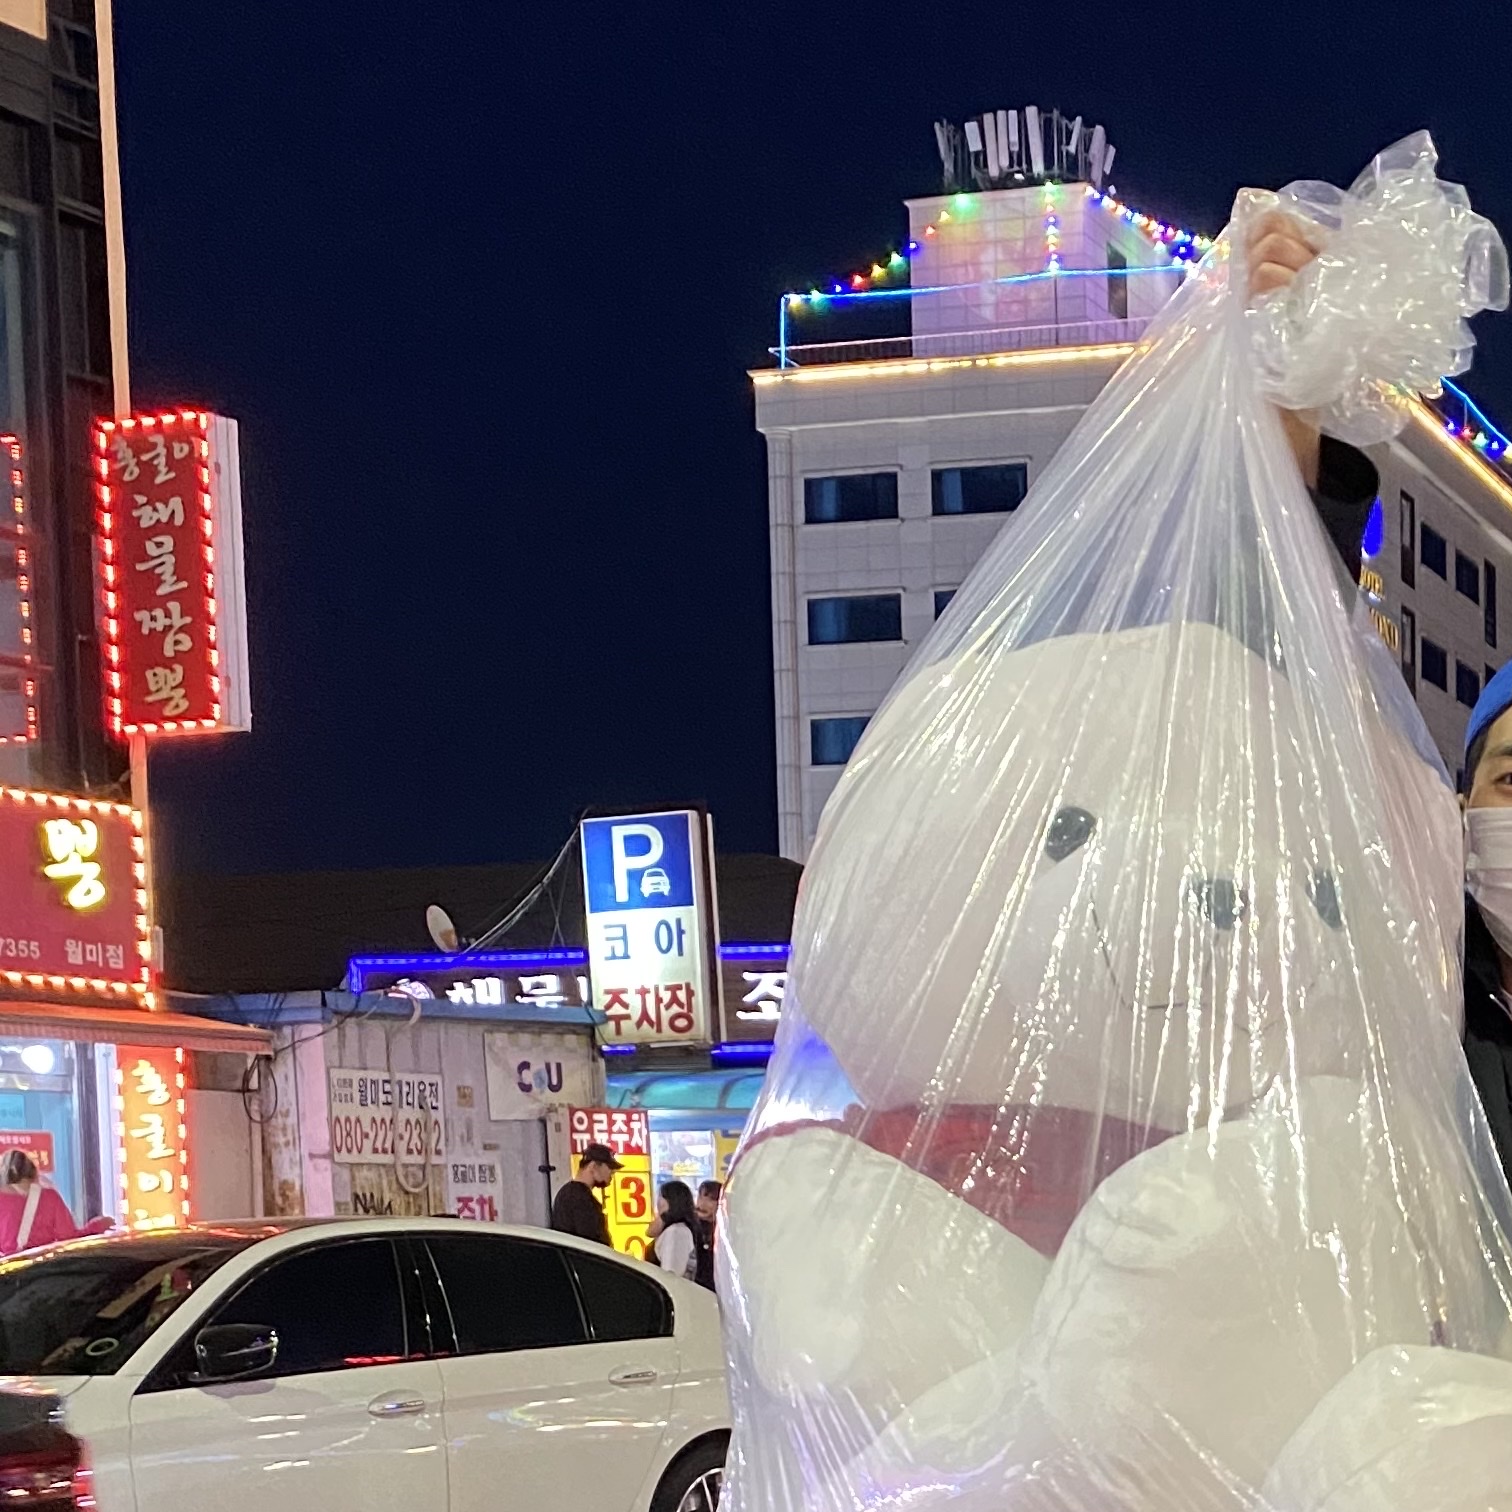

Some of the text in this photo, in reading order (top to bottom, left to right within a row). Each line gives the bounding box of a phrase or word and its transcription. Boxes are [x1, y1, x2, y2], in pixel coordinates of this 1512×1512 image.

[132, 493, 192, 717] 해물짬뽕
[43, 816, 107, 910] 뽕
[610, 823, 664, 903] P
[63, 937, 124, 970] 월미점
[602, 981, 696, 1036] 주차장
[516, 1059, 563, 1094] CU
[572, 1110, 648, 1154] 유료주차
[620, 1176, 647, 1219] 3
